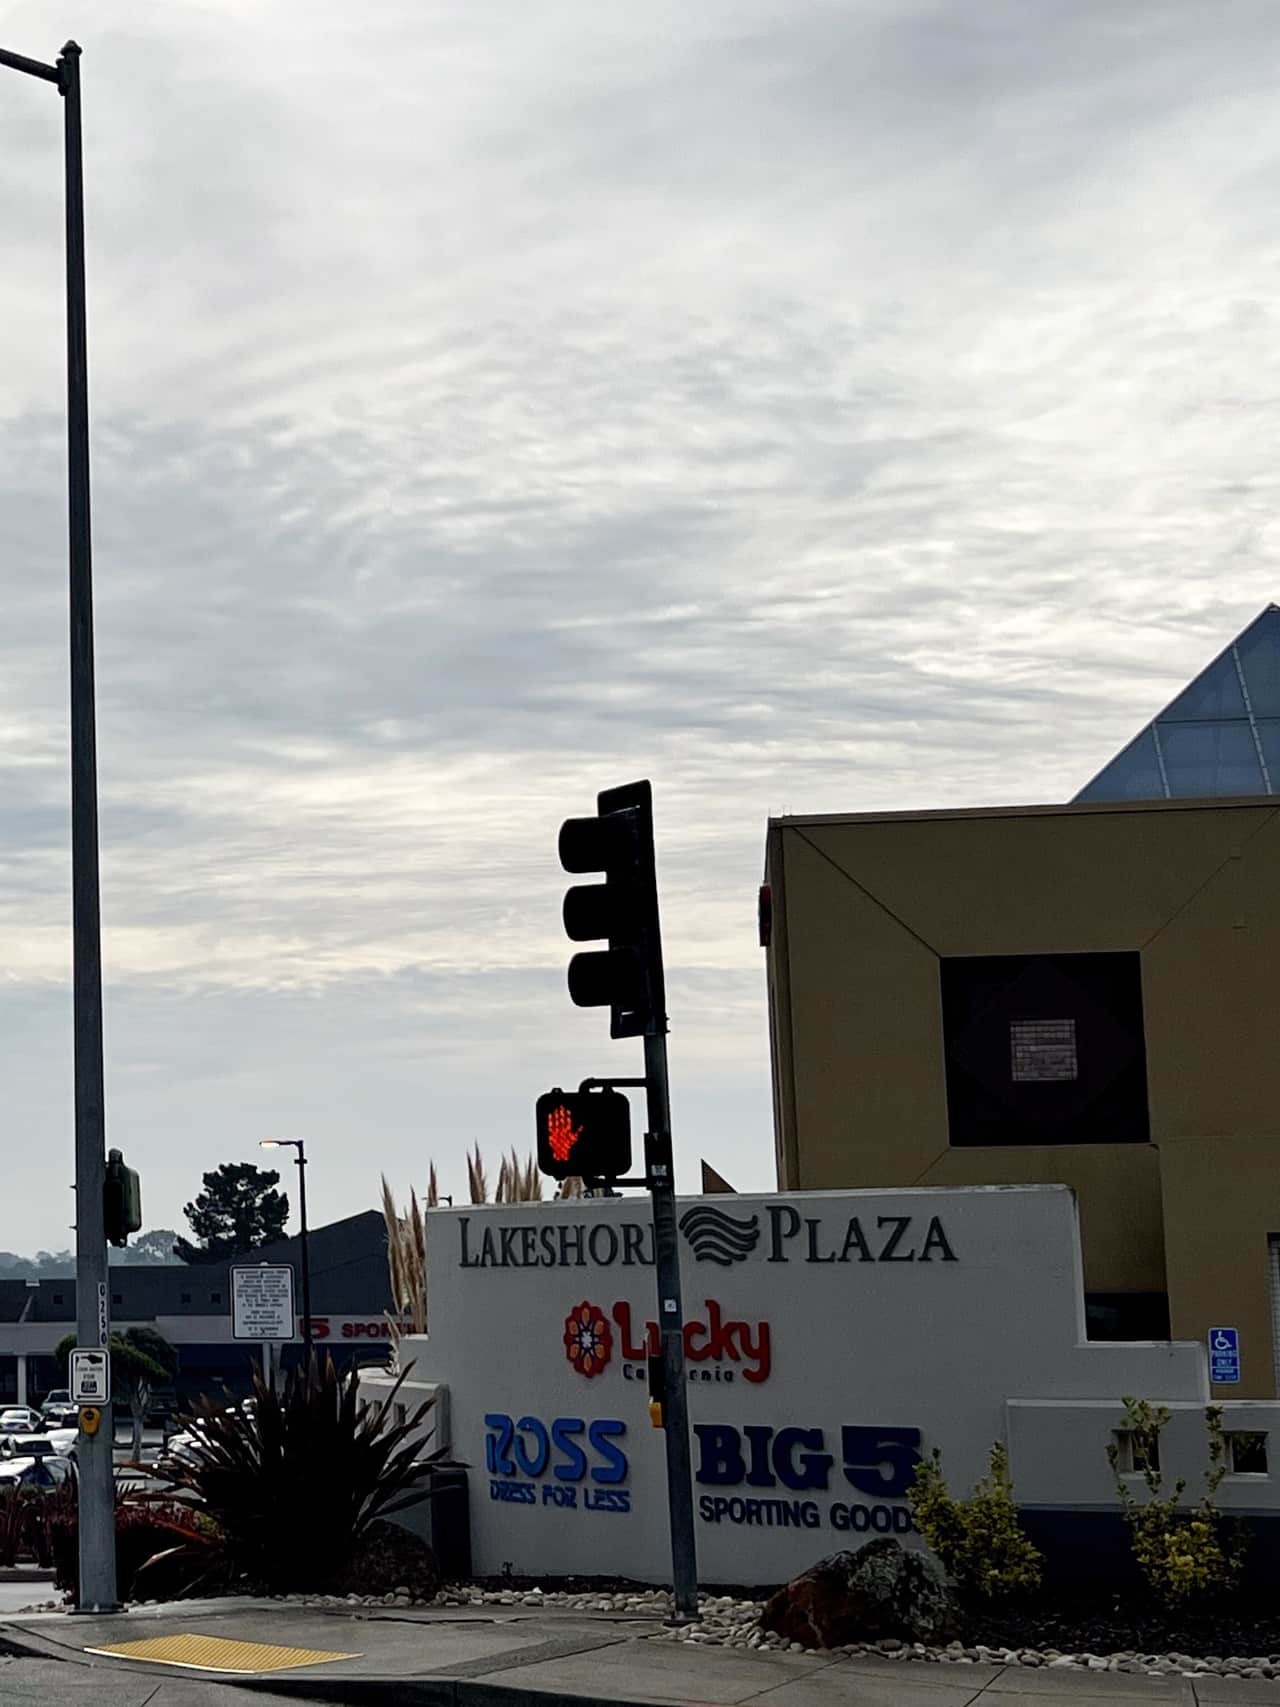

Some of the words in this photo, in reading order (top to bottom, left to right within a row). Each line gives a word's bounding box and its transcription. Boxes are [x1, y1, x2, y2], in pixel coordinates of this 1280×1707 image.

[458, 1217, 657, 1268] LAKESHOR
[766, 1205, 959, 1263] PLAZA
[623, 1364, 734, 1382] Carnia
[484, 1414, 628, 1483] ROSS
[693, 1424, 833, 1490] BIG
[841, 1425, 924, 1498] 5
[490, 1480, 536, 1504] DRESS
[542, 1484, 577, 1509] FOR
[584, 1488, 630, 1512] LESS
[699, 1495, 820, 1529] SPORTING
[829, 1502, 920, 1535] GOOD
